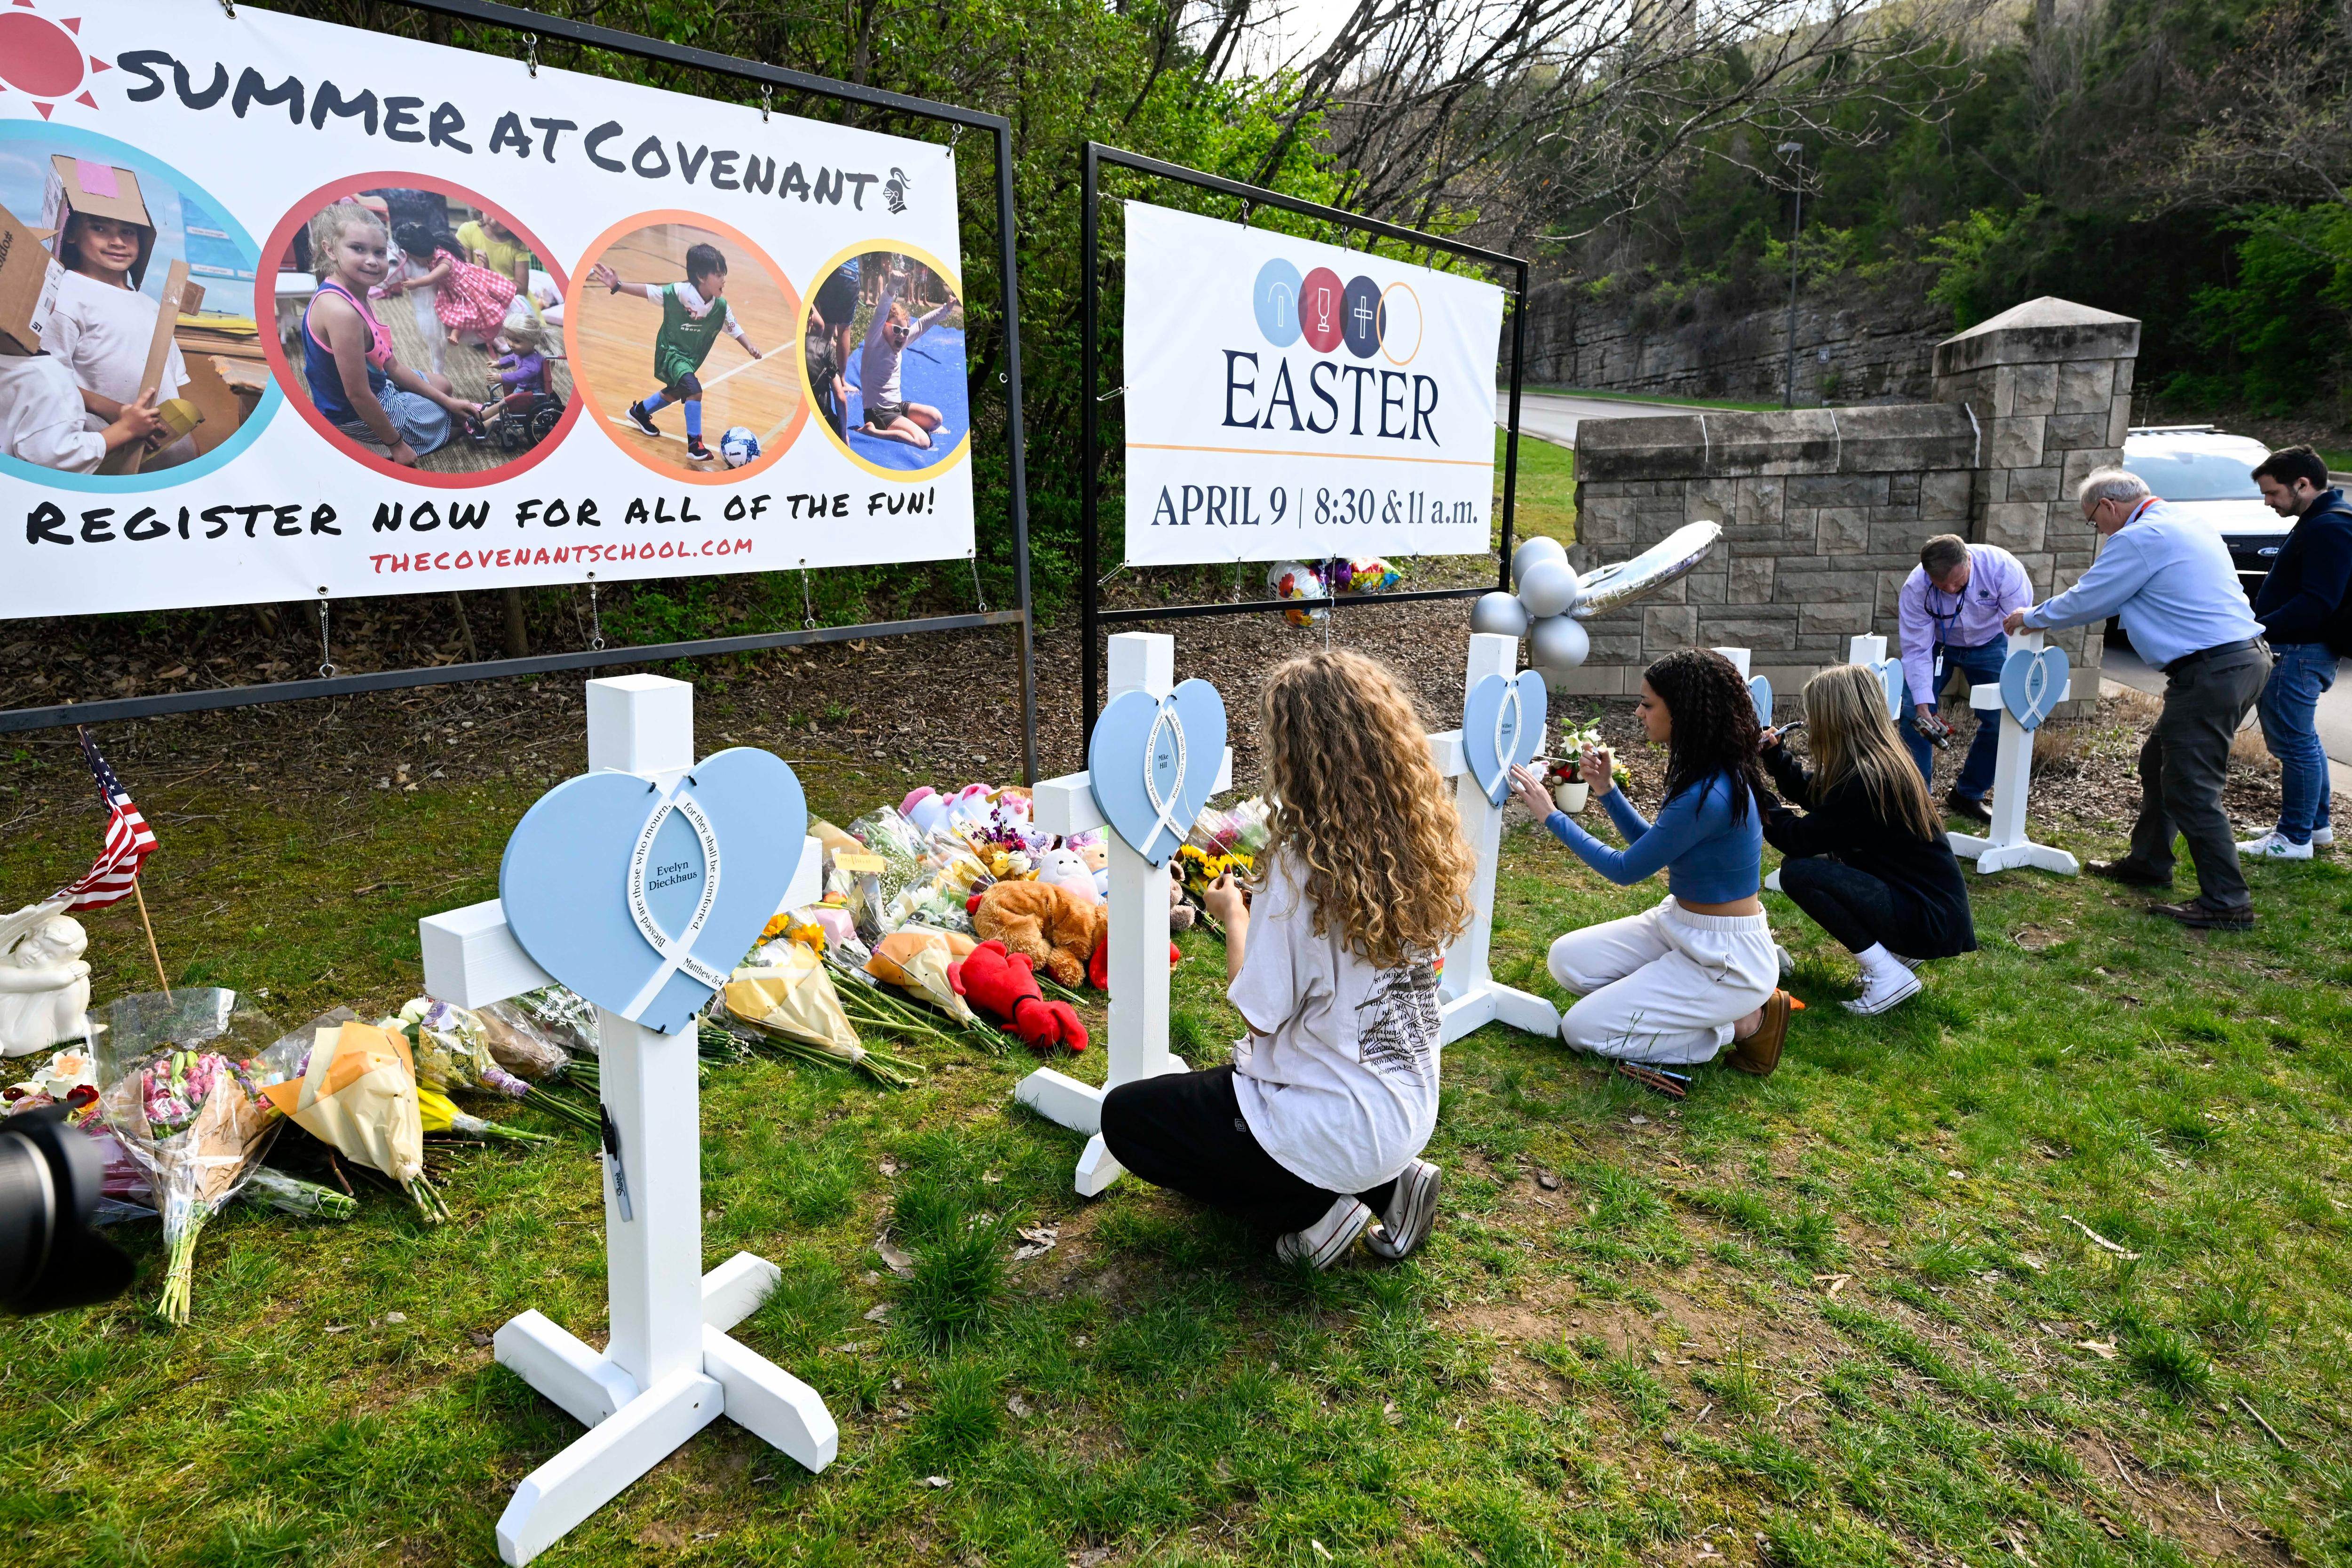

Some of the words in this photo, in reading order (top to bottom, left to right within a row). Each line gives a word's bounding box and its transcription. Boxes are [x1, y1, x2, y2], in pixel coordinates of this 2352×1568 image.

[117, 50, 472, 154] SUMMER
[489, 111, 578, 163] AT
[584, 120, 879, 211] COVENANT
[1222, 349, 1440, 447] EASTER
[26, 501, 342, 545] REGISTER
[373, 501, 490, 533] NOW
[517, 498, 601, 528] FOR
[625, 497, 701, 524] ALL
[724, 495, 771, 521] OF
[787, 493, 849, 519] THE
[868, 487, 934, 516] FUN!
[1151, 485, 1260, 528] APRIL
[1270, 487, 1286, 525] 9
[1315, 488, 1375, 524] 8:30
[1383, 490, 1402, 524] &
[1409, 491, 1423, 523] 11
[1431, 501, 1477, 523] a.m.
[370, 538, 752, 574] THECOVENANTSCHOOL.COM
[683, 802, 696, 816] for
[1150, 787, 1161, 808] Blessed
[645, 804, 671, 838] mourn,
[695, 814, 708, 834] they
[1168, 817, 1181, 833] Matthew
[636, 841, 647, 865] who
[705, 835, 717, 858] shall
[657, 861, 689, 876] Evelyn
[710, 860, 718, 873] be
[633, 868, 641, 898] those
[649, 871, 697, 891] Dieckhaus
[636, 899, 646, 916] are
[691, 875, 715, 930] comforted.
[640, 916, 666, 947] Blessed
[683, 957, 712, 979] Matthew
[712, 975, 724, 987] 5:4
[616, 1170, 626, 1197] Sharpie
